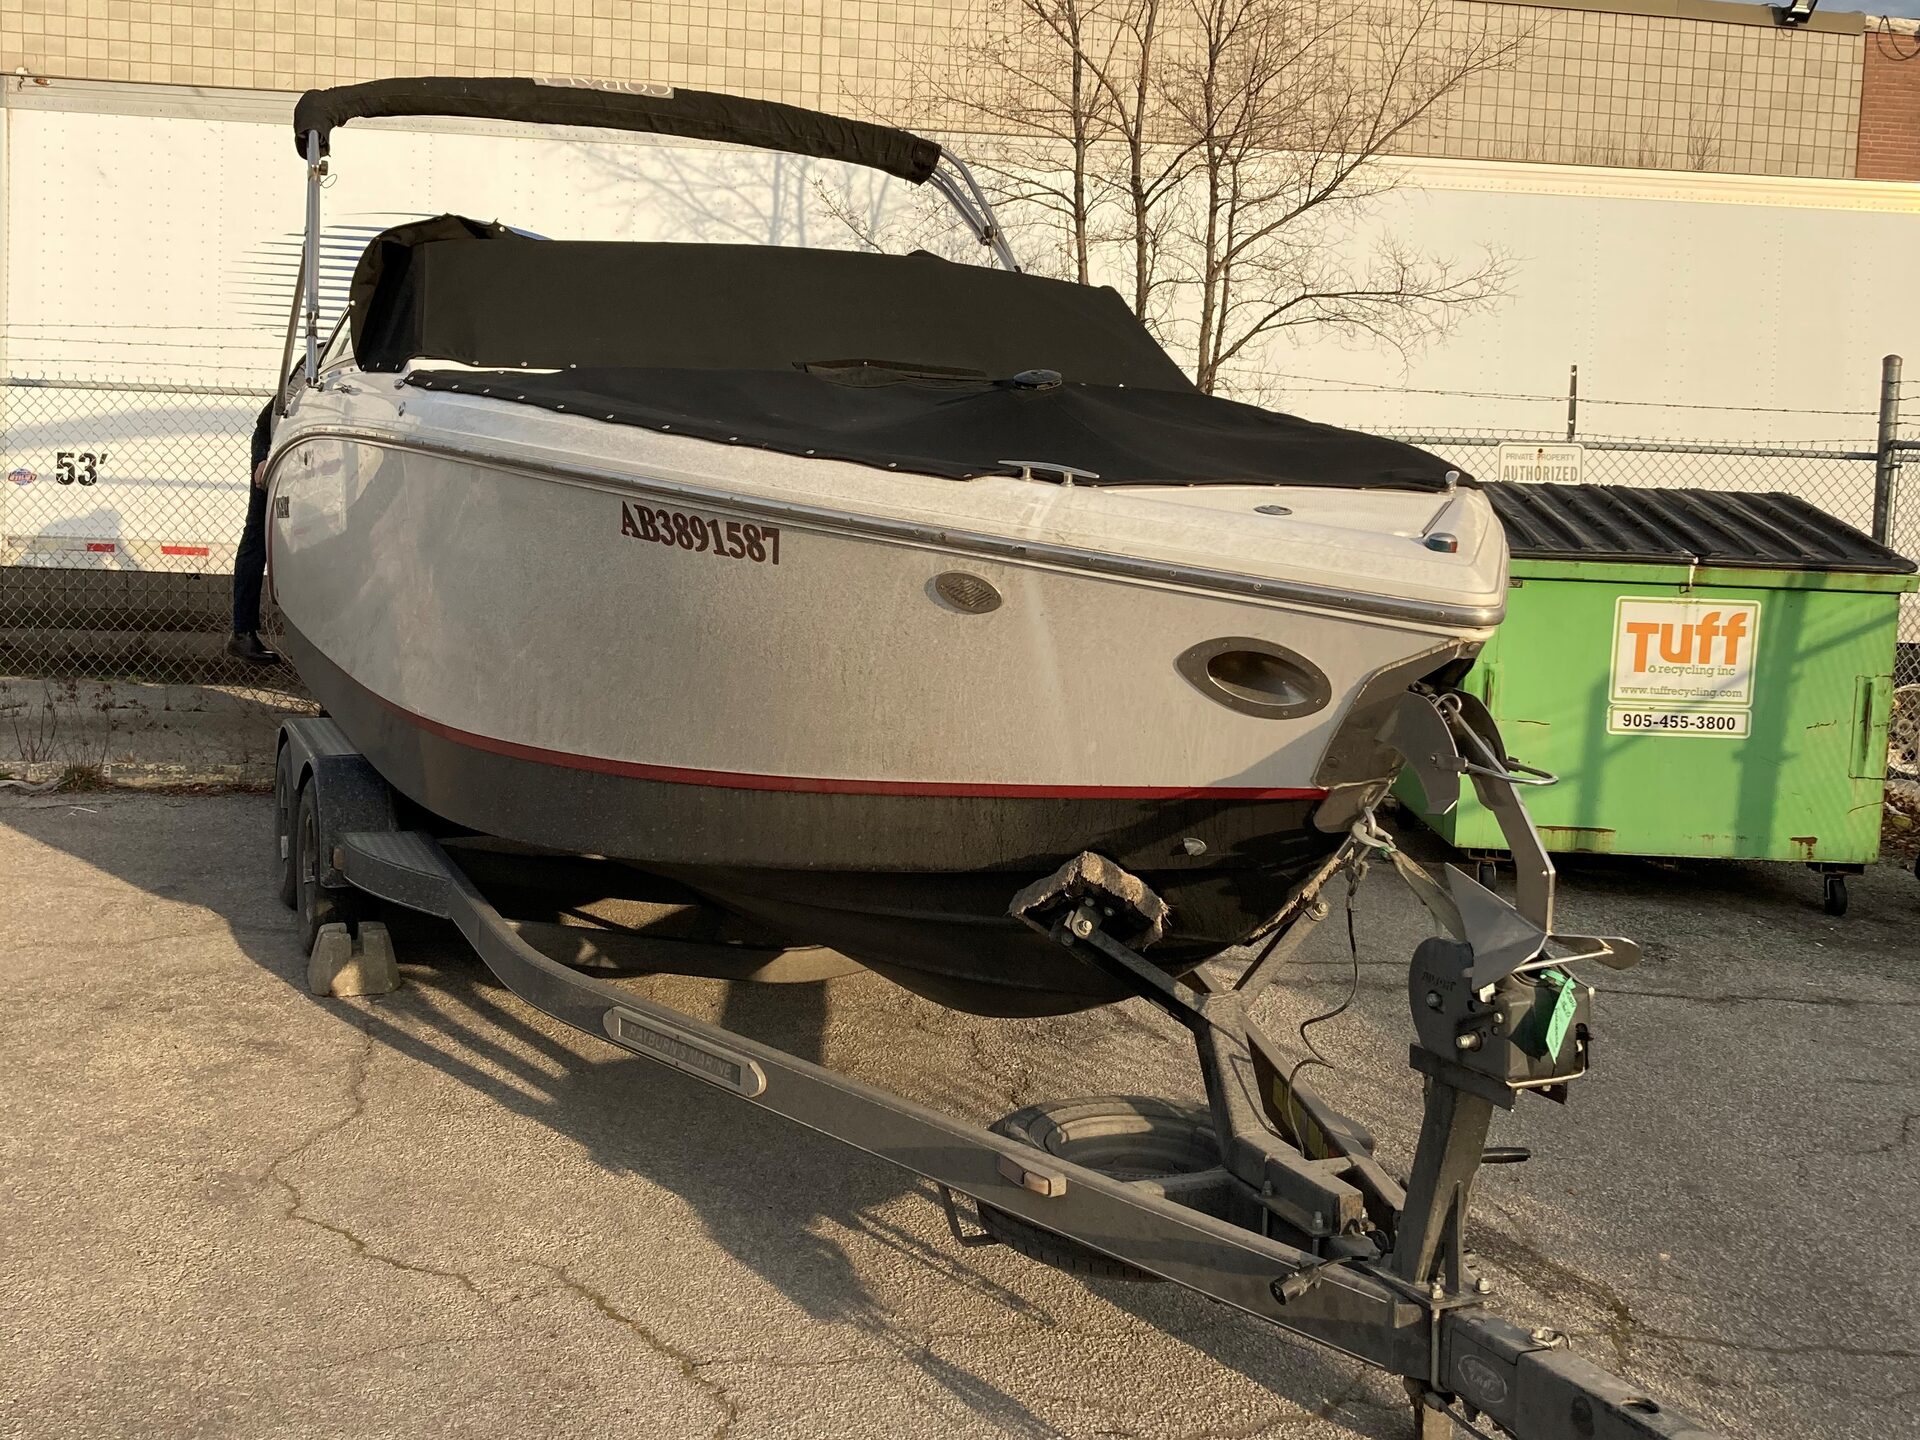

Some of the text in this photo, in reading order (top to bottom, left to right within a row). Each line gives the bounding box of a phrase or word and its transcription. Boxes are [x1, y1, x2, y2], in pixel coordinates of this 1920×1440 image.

[543, 78, 672, 95] COBA
[1506, 453, 1575, 461] PRIVATE PROPERTY
[1503, 465, 1578, 482] AUTHORIZED
[621, 501, 780, 565] AB3891587
[1627, 613, 1747, 672] Tuff
[1658, 665, 1736, 677] recycling inc
[1620, 686, 1742, 699] www.tuffrecycling.com
[1623, 714, 1736, 730] 905-455-3800
[687, 1049, 731, 1077] MARINE
